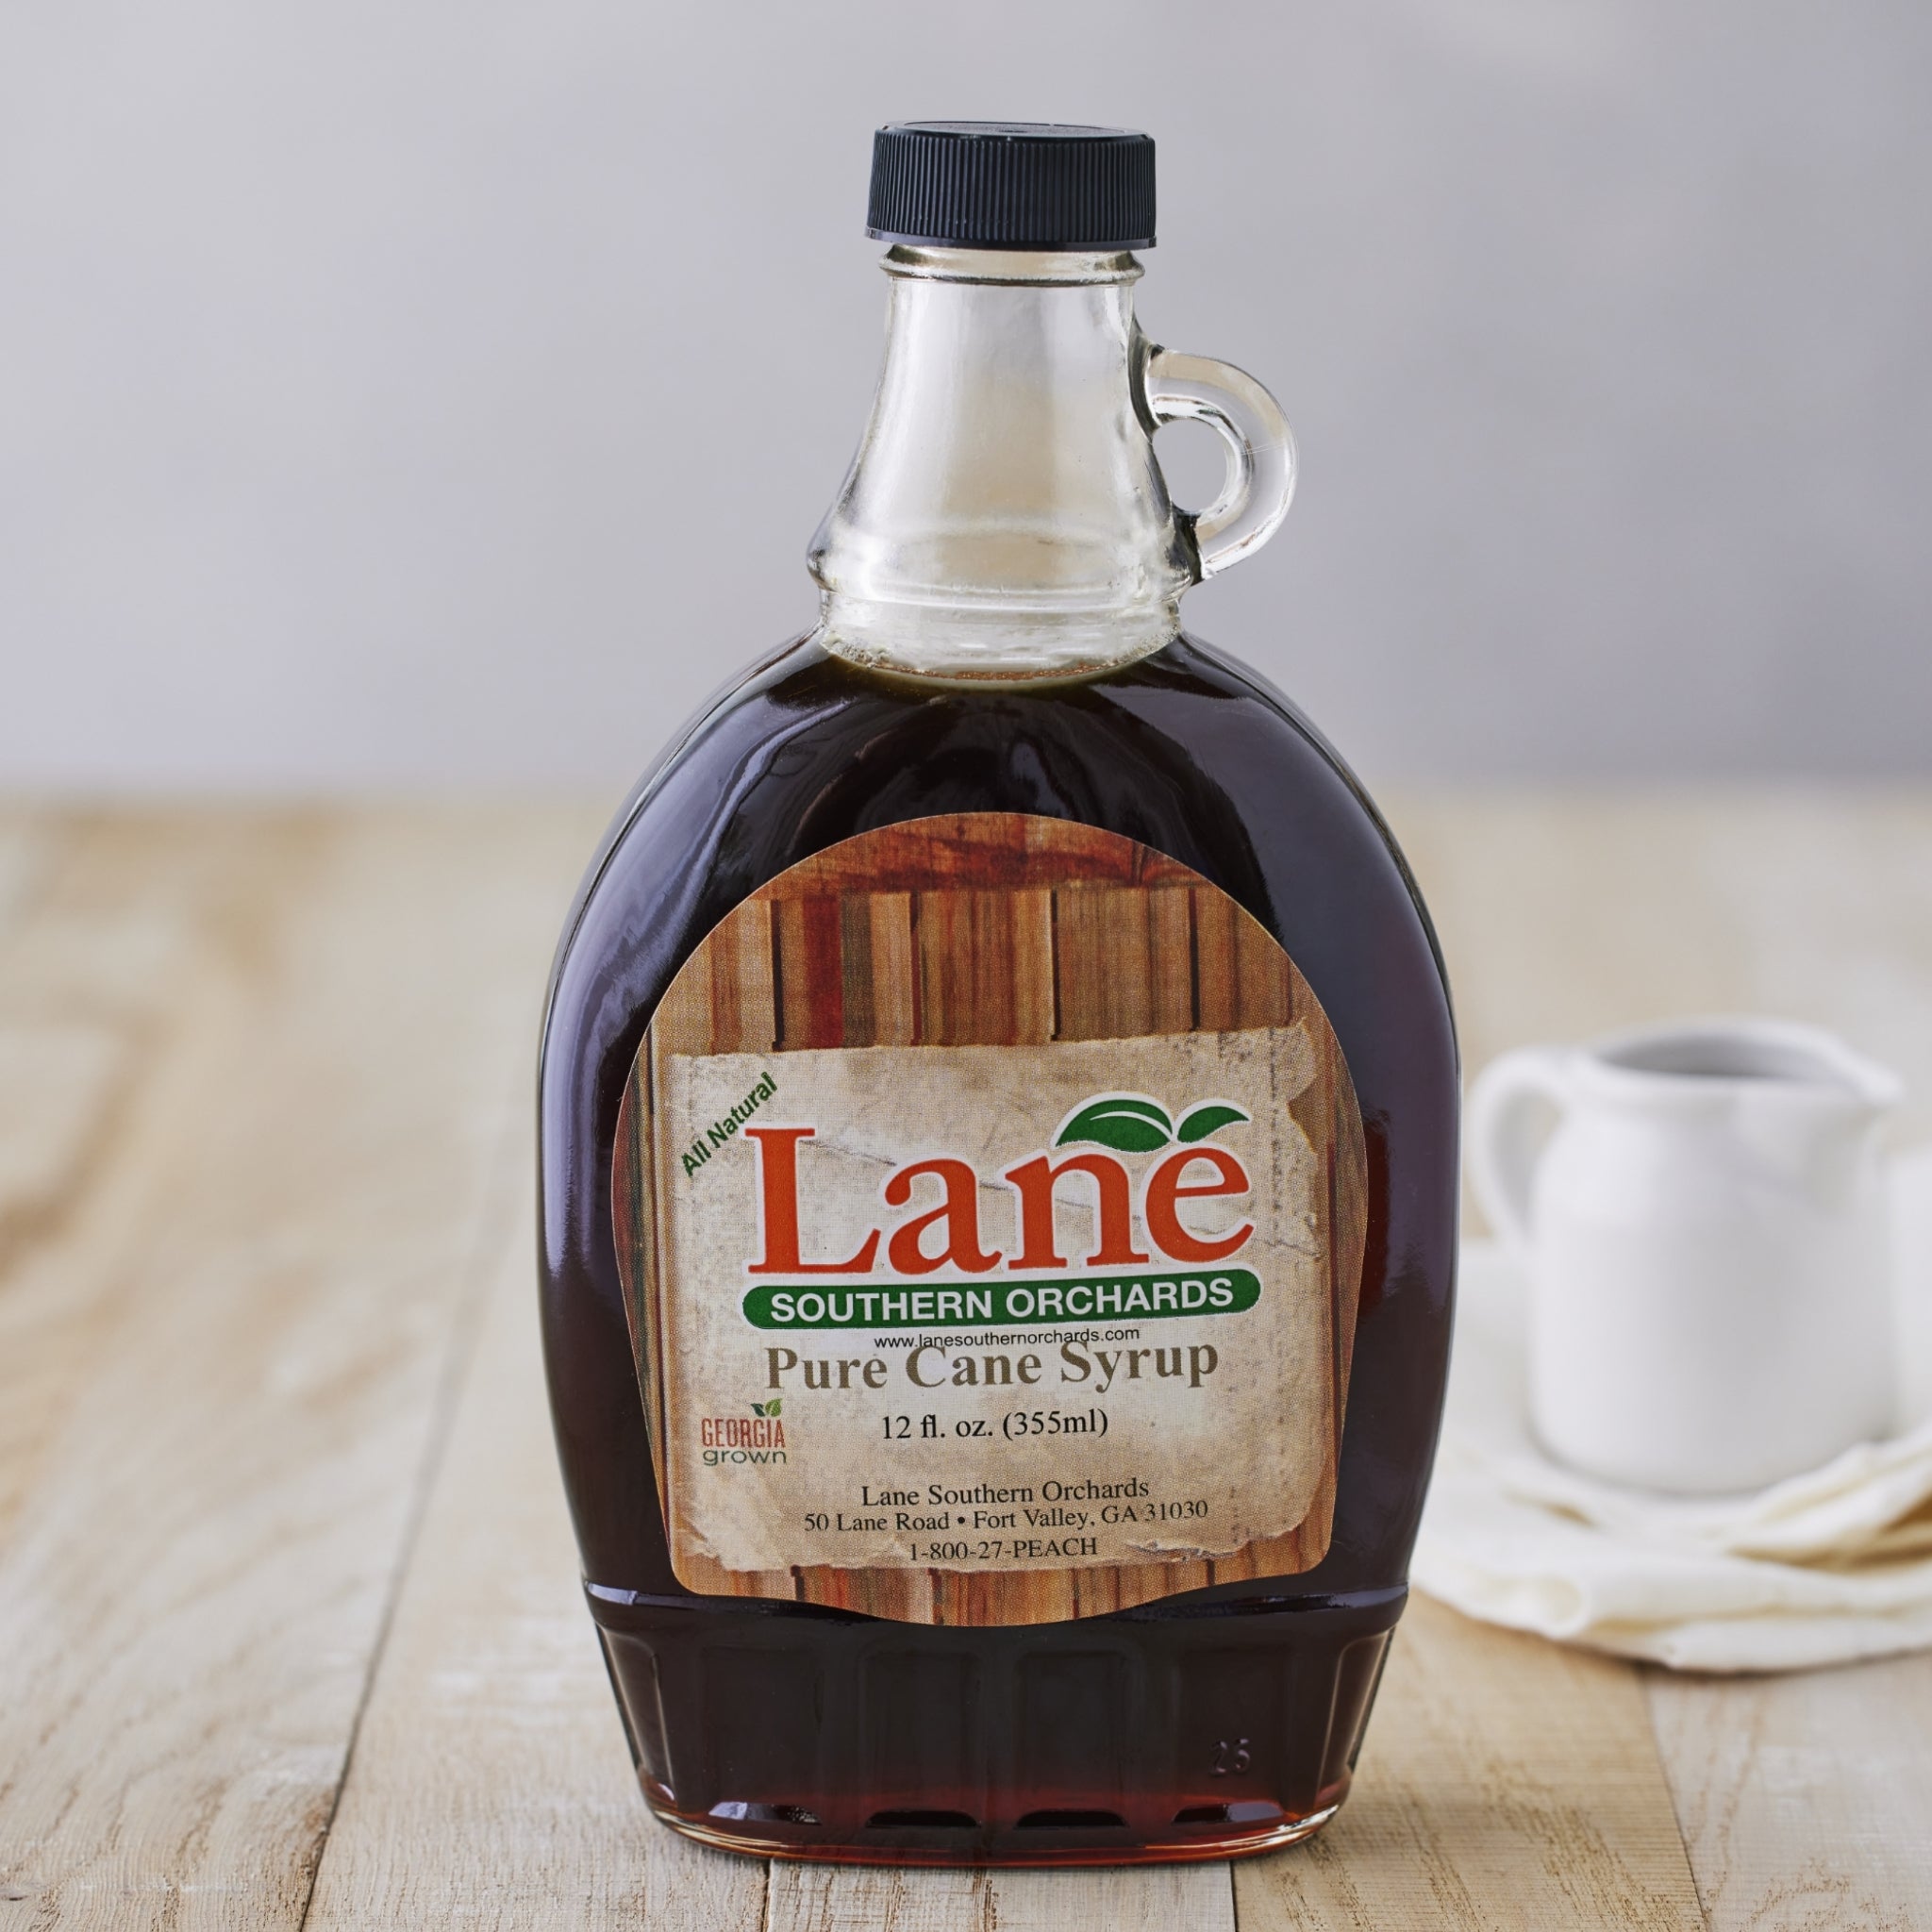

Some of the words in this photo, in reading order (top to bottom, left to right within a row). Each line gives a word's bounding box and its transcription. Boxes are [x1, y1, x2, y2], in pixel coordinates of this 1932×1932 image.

[681, 1140, 712, 1176] All
[706, 1071, 778, 1148] Natural
[745, 1127, 1255, 1275] Lane
[771, 1289, 993, 1323] SOUTHERN
[1006, 1278, 1235, 1318] ORCHARDS
[874, 1327, 1141, 1348] www.lanesouthernorchards.com
[765, 1346, 889, 1391] Pure
[905, 1346, 1042, 1388] Cane
[1059, 1341, 1219, 1393] Syrup
[701, 1417, 786, 1448] GEORGIA
[881, 1416, 911, 1440] 12
[920, 1413, 946, 1439] fl.
[956, 1419, 994, 1438] oz.
[1003, 1407, 1108, 1441] (355ml)
[702, 1449, 787, 1467] grown
[861, 1484, 919, 1507] Lane
[928, 1482, 1033, 1506] Southern
[1041, 1476, 1149, 1502] Orchards
[804, 1511, 829, 1532] 50
[836, 1511, 887, 1532] Lane
[895, 1509, 950, 1531] Road
[974, 1507, 1018, 1529] Fort
[1100, 1504, 1139, 1525] GA
[1144, 1500, 1208, 1523] 31030
[909, 1536, 1097, 1562] 1-800-27-PEACH
